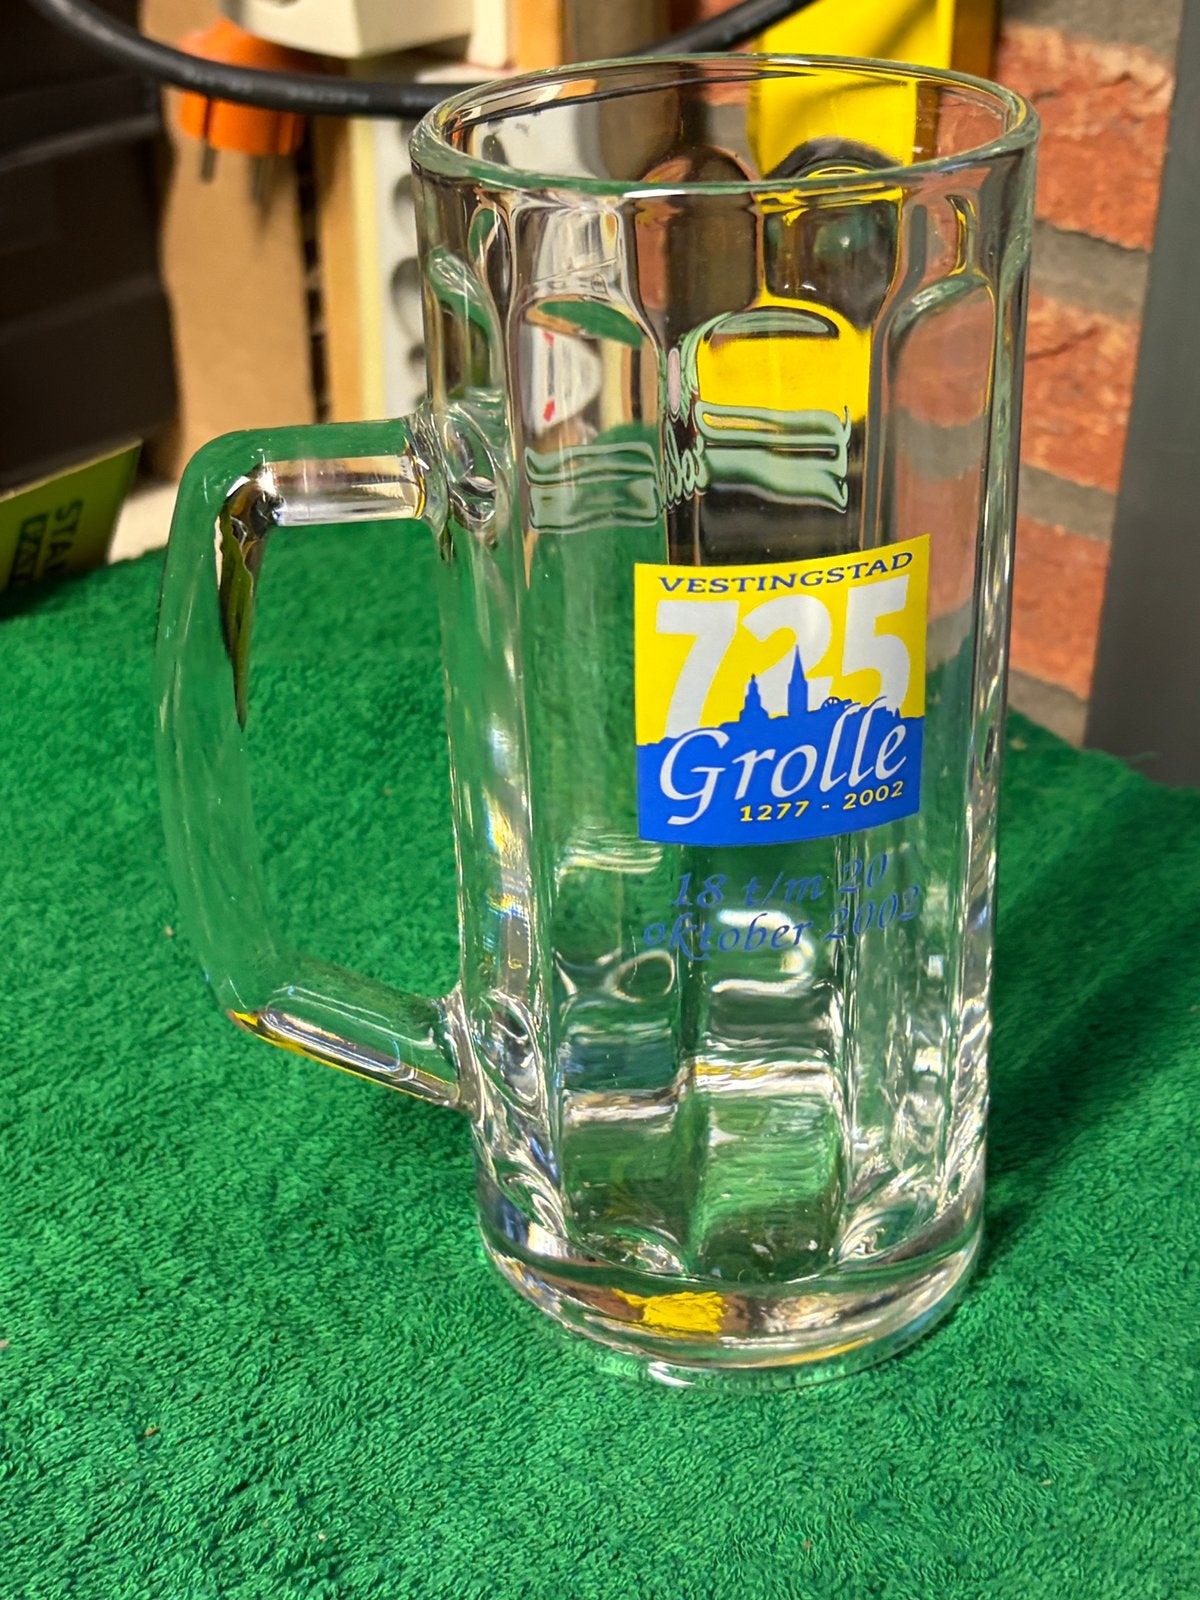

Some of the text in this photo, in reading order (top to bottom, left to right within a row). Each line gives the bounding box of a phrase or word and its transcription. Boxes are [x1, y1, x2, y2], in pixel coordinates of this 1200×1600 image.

[660, 552, 913, 593] VESTINGSTAD
[655, 574, 911, 739] 725
[659, 696, 907, 826] Grolle
[740, 800, 810, 822] 1277
[842, 780, 905, 811] 2002
[670, 853, 888, 908] 18 t/m 20
[643, 884, 920, 961] oktober 2002
